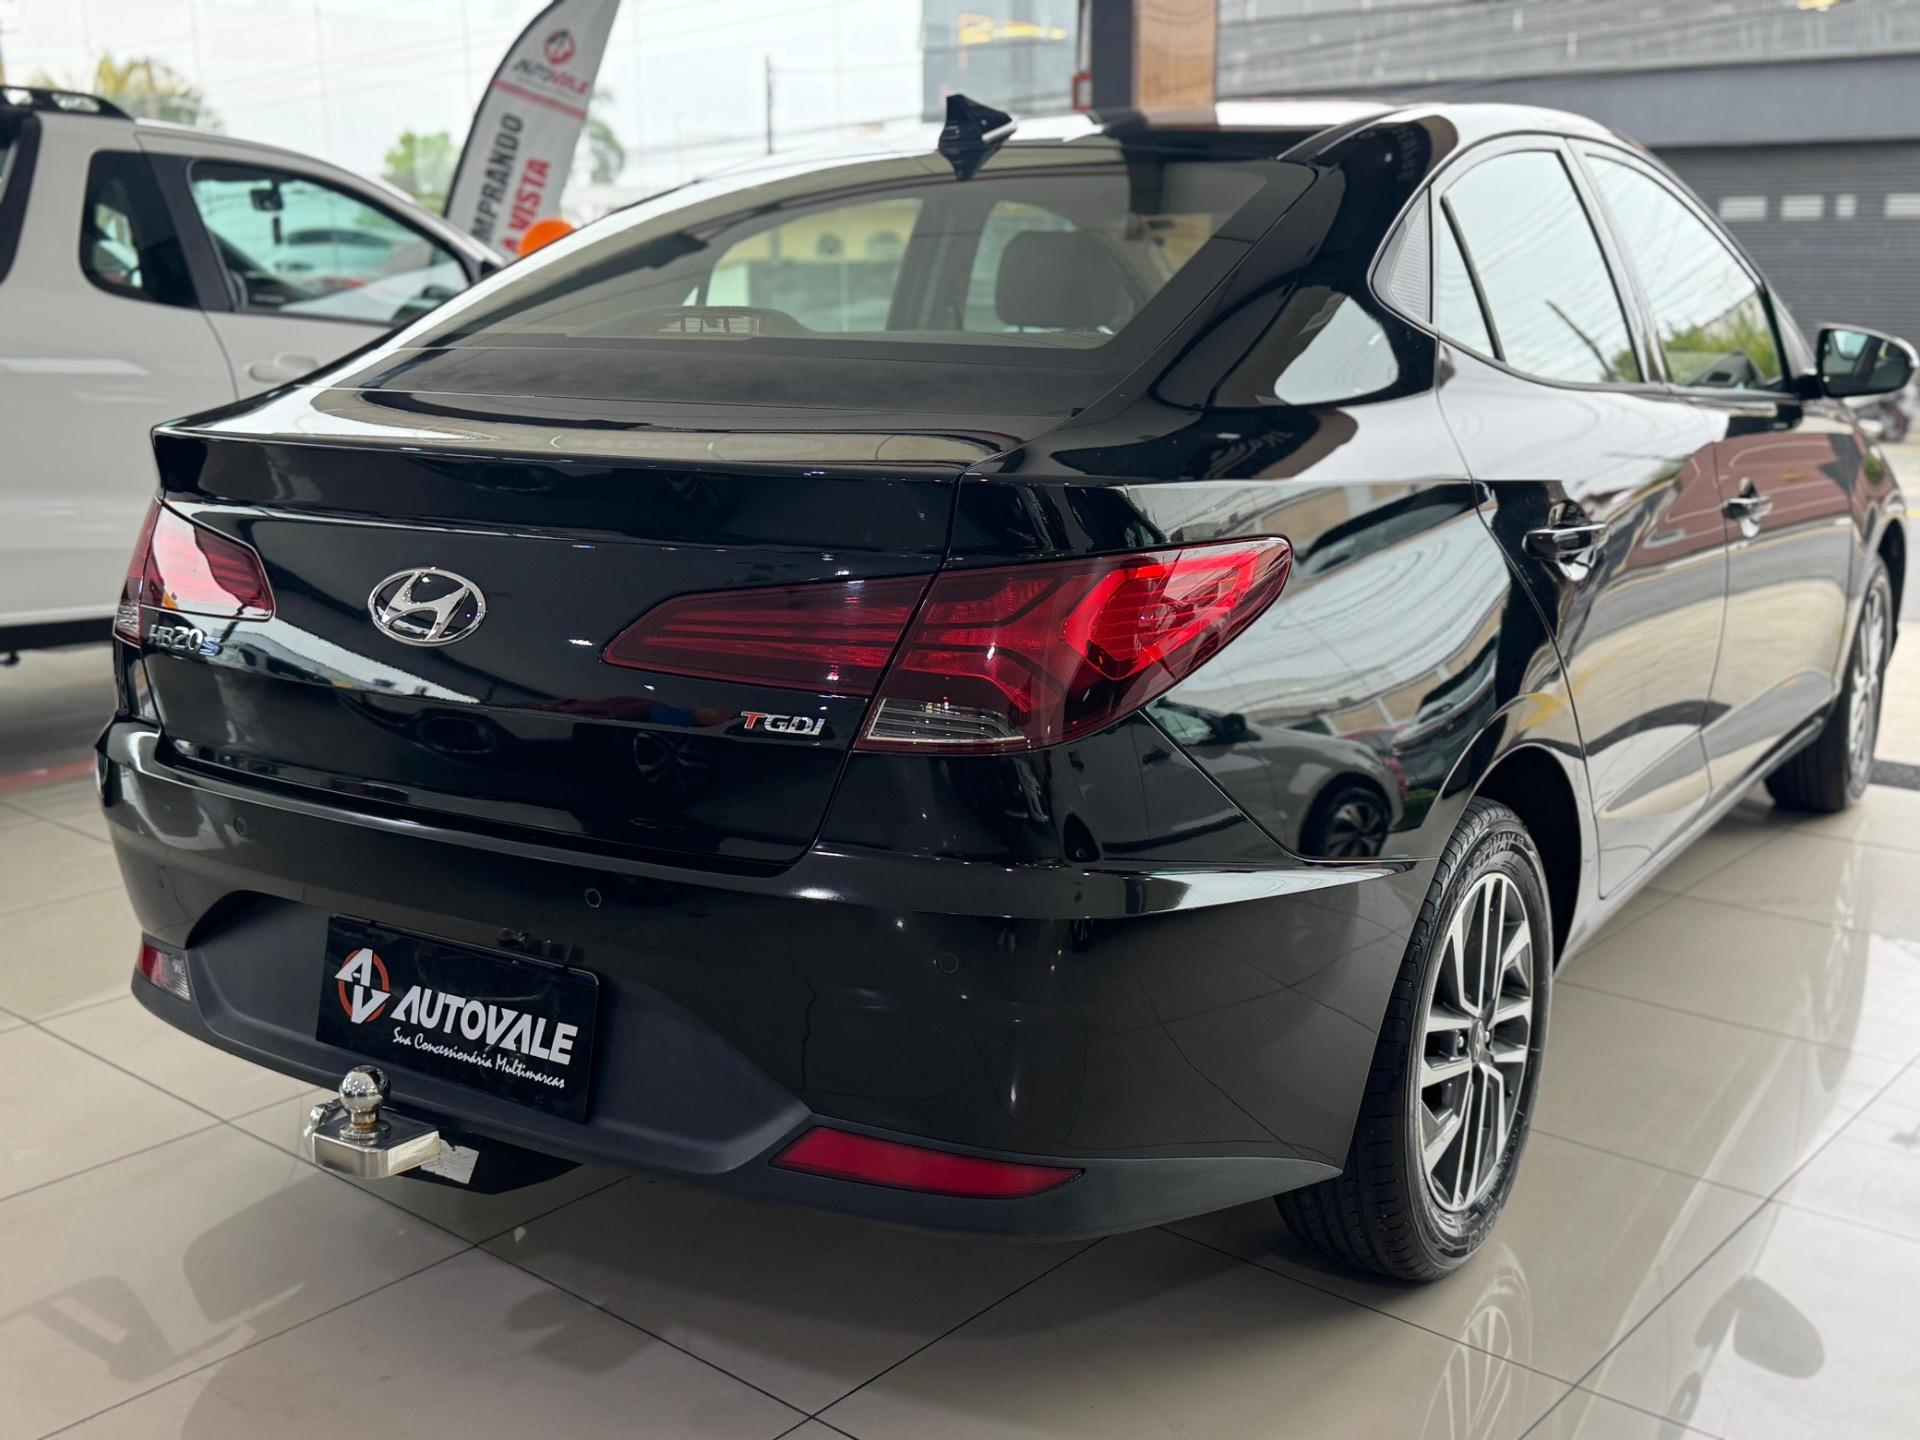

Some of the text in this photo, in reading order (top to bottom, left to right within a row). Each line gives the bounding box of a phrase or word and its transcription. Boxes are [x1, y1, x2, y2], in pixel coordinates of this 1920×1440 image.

[471, 113, 524, 242] MPRANDO
[508, 159, 551, 230] VISTA
[390, 985, 579, 1065] AUTOVALE
[393, 1026, 566, 1089] Sua Concessionária Multimarcas
